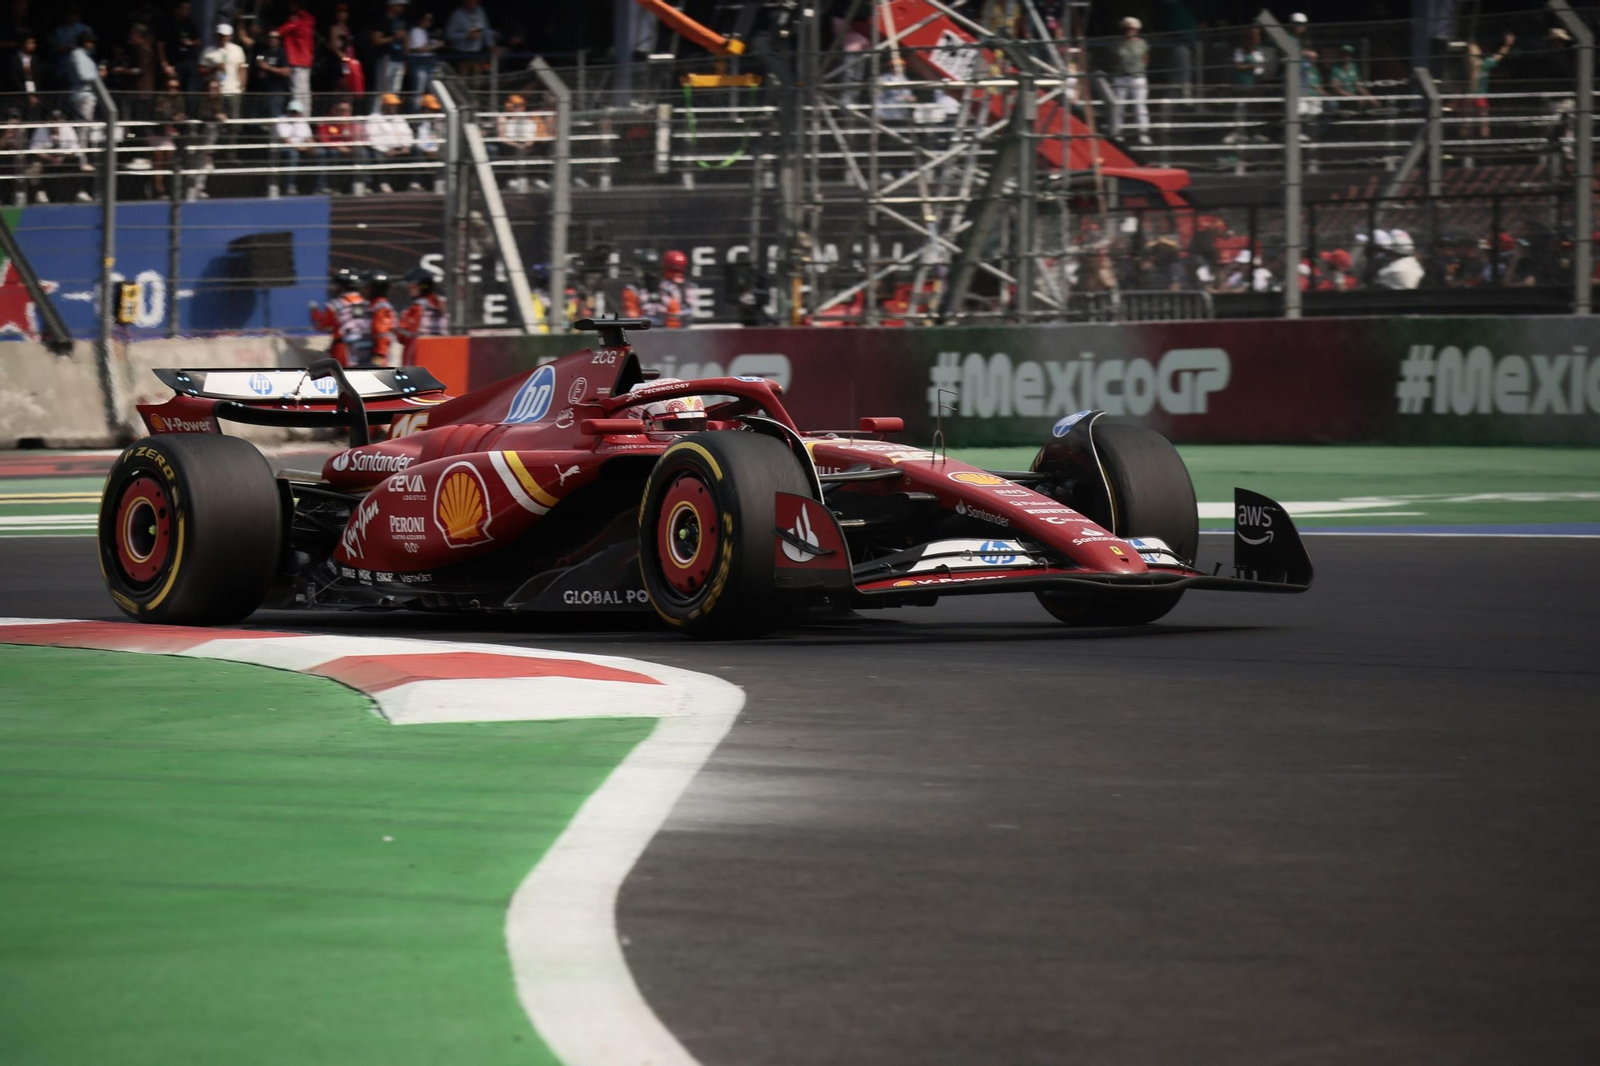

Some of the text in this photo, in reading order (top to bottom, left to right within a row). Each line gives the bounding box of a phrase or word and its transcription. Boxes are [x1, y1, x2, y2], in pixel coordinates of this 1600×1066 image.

[591, 350, 617, 364] ZCG
[252, 373, 270, 394] hp
[644, 382, 690, 395] TECHNOLOGY
[927, 348, 1231, 417] #MexicoGP
[505, 366, 551, 421] hp
[164, 416, 211, 433] V-Power
[135, 446, 176, 482] ZERO
[349, 450, 415, 472] Santander
[389, 514, 425, 532] PERONI
[966, 504, 1010, 527] Santander
[1237, 504, 1273, 528] aws
[375, 571, 394, 582] SKF
[916, 574, 1007, 585] V-Power
[563, 589, 625, 605] GLOBAL
